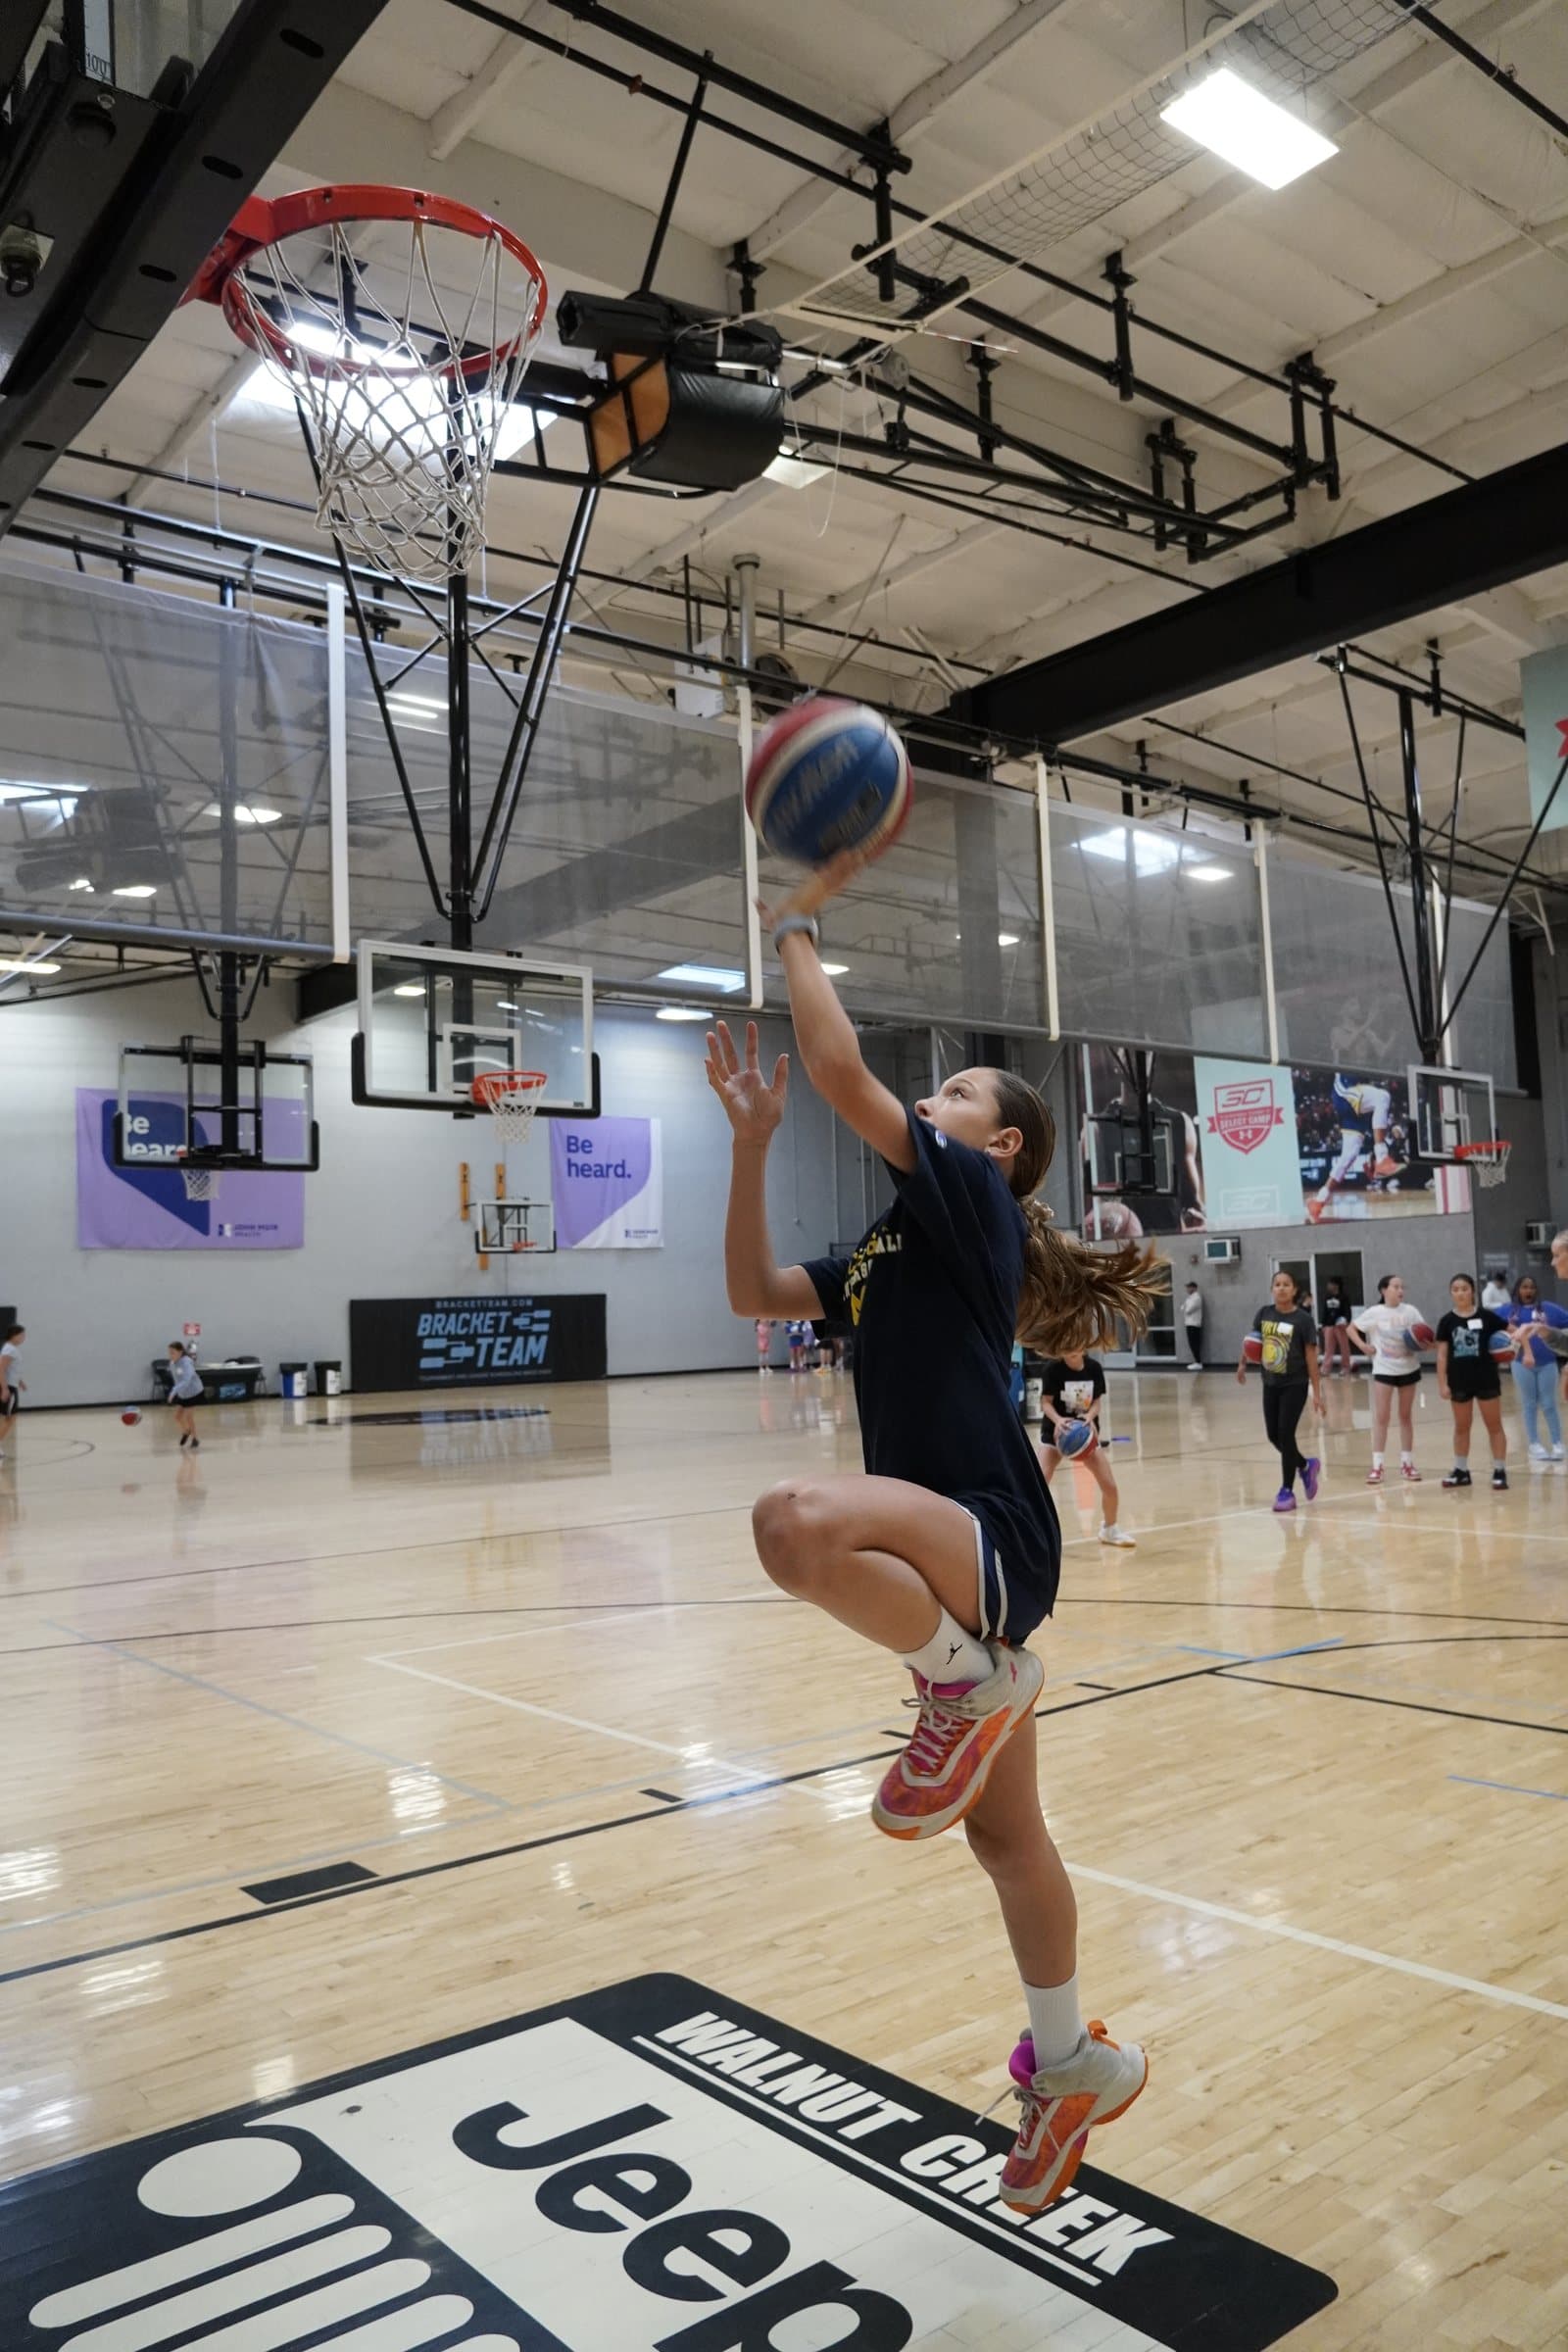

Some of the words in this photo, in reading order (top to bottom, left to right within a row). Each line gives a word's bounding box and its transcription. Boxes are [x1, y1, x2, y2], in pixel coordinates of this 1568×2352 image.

[1249, 1112, 1270, 1125] CAMP
[566, 1135, 593, 1154] Be
[566, 1157, 632, 1179] heard.
[434, 1298, 533, 1309] BRACKETTEAM.COM
[416, 1311, 512, 1337] BRACKET
[475, 1335, 549, 1367] TEAM
[654, 2011, 924, 2140] WALNUT
